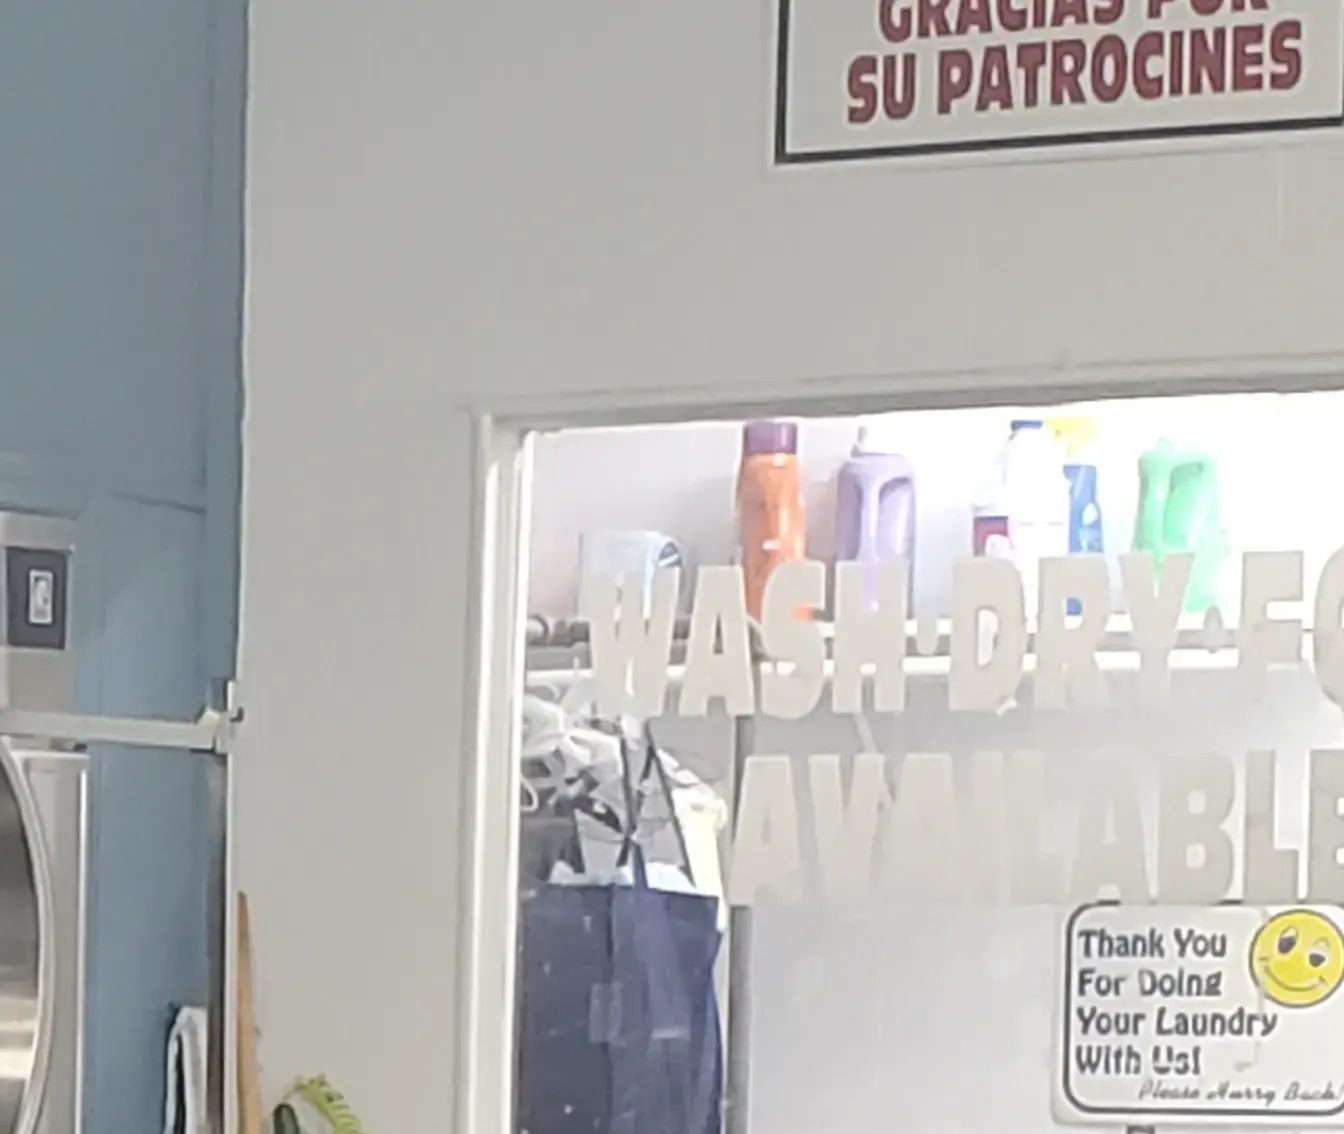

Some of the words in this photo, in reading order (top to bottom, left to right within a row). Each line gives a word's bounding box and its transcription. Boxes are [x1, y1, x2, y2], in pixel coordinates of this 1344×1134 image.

[846, 52, 914, 124] SU
[936, 19, 1303, 114] PATROCINES
[582, 560, 906, 720] WASH
[1079, 928, 1165, 959] Thank
[1174, 928, 1227, 959] You
[1078, 967, 1127, 998] For
[1138, 966, 1222, 998] Doing
[1077, 1006, 1146, 1038] Your
[1155, 1006, 1278, 1040] Laundry
[1076, 1045, 1142, 1077] With
[1152, 1045, 1202, 1077] Us!
[1138, 1079, 1200, 1101] Please
